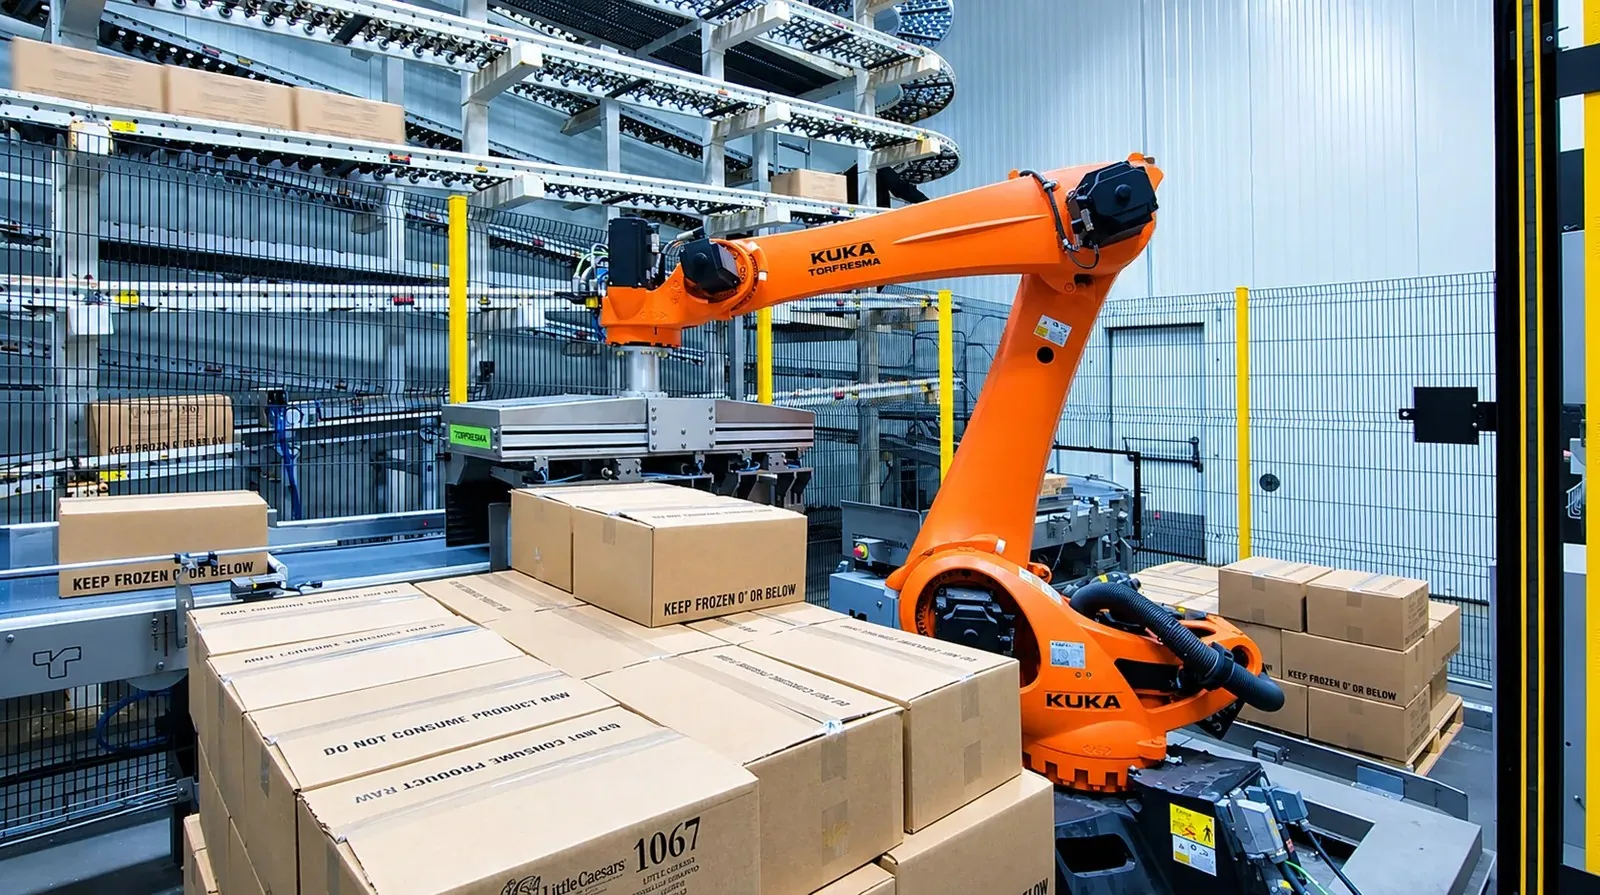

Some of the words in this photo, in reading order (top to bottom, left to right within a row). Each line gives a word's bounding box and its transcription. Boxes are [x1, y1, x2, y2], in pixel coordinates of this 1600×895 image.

[808, 257, 882, 277] TORFRESMA
[810, 243, 876, 265] KUKA
[73, 576, 110, 591] KEEP
[114, 570, 168, 587] FROZEN
[189, 566, 206, 579] OR
[210, 561, 254, 577] BELOW
[664, 599, 692, 617] KEEP
[695, 592, 736, 611] FROZEN
[750, 588, 763, 603] OR
[765, 583, 797, 600] BELOW
[1287, 669, 1308, 681] KEEP
[1309, 674, 1340, 690] FROZEN
[1352, 684, 1364, 694] OR
[1366, 686, 1397, 701] BELOW
[1046, 693, 1122, 709] KUKA
[323, 744, 349, 756] DO
[353, 734, 387, 749] NOT
[391, 716, 470, 739] CONSUME
[471, 699, 538, 720] PRODUCT
[540, 691, 571, 703] RAW
[488, 738, 566, 765] CONSUME
[403, 761, 487, 791] PRODUCT
[355, 786, 398, 804] RAW
[633, 816, 701, 874] 1067
[543, 876, 578, 895] Little
